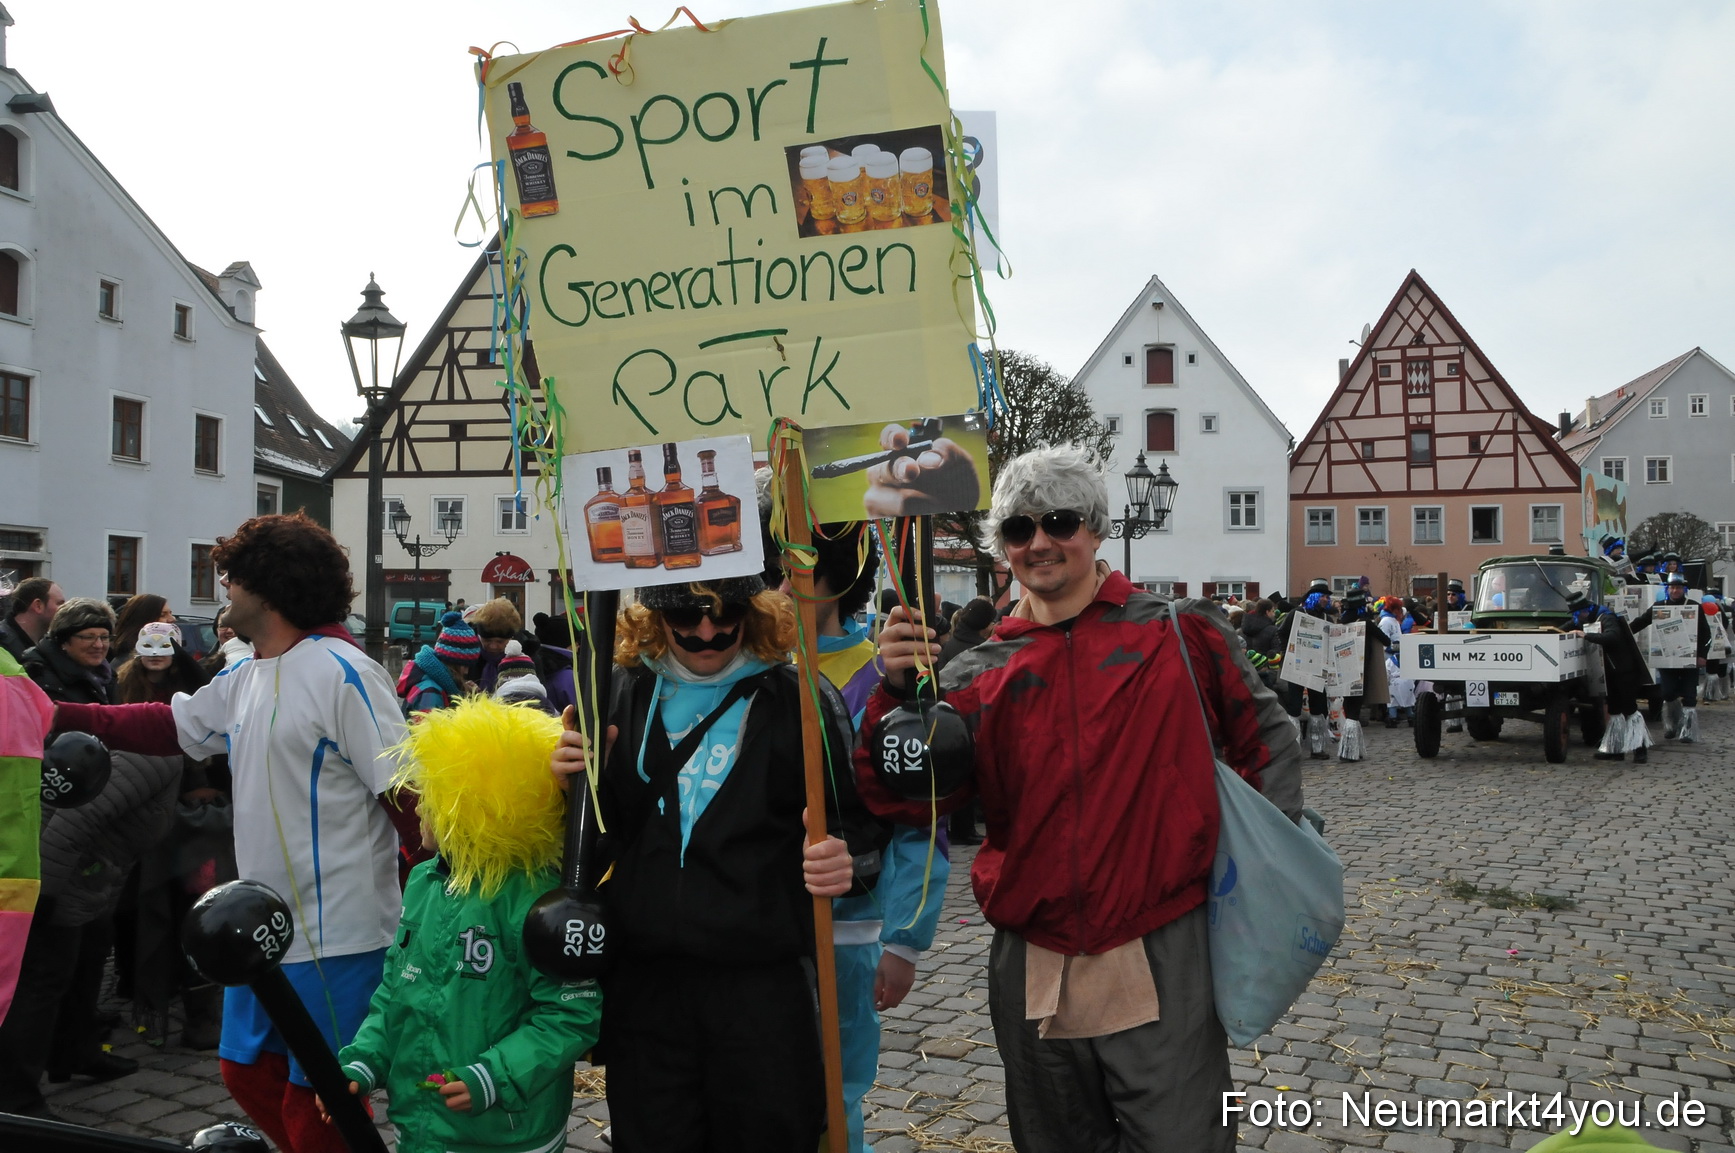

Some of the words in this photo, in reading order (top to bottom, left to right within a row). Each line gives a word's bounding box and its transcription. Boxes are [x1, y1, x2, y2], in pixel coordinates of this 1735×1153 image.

[552, 37, 848, 190] Sport
[683, 178, 777, 227] im
[539, 228, 916, 328] Generationen
[612, 335, 850, 435] Park
[492, 564, 531, 582] Splash
[1423, 659, 1431, 667] D
[1442, 652, 1461, 661] NM
[1468, 652, 1486, 661] MZ
[1493, 652, 1523, 662] 1000
[1469, 682, 1486, 696] 29
[883, 734, 900, 774] 250
[904, 737, 923, 771] KG
[44, 768, 73, 793] 250
[253, 924, 280, 960] 250
[271, 911, 291, 942] KG
[563, 918, 585, 957] 250
[587, 923, 605, 955] KG
[459, 927, 494, 974] 19
[233, 1127, 260, 1140] KG
